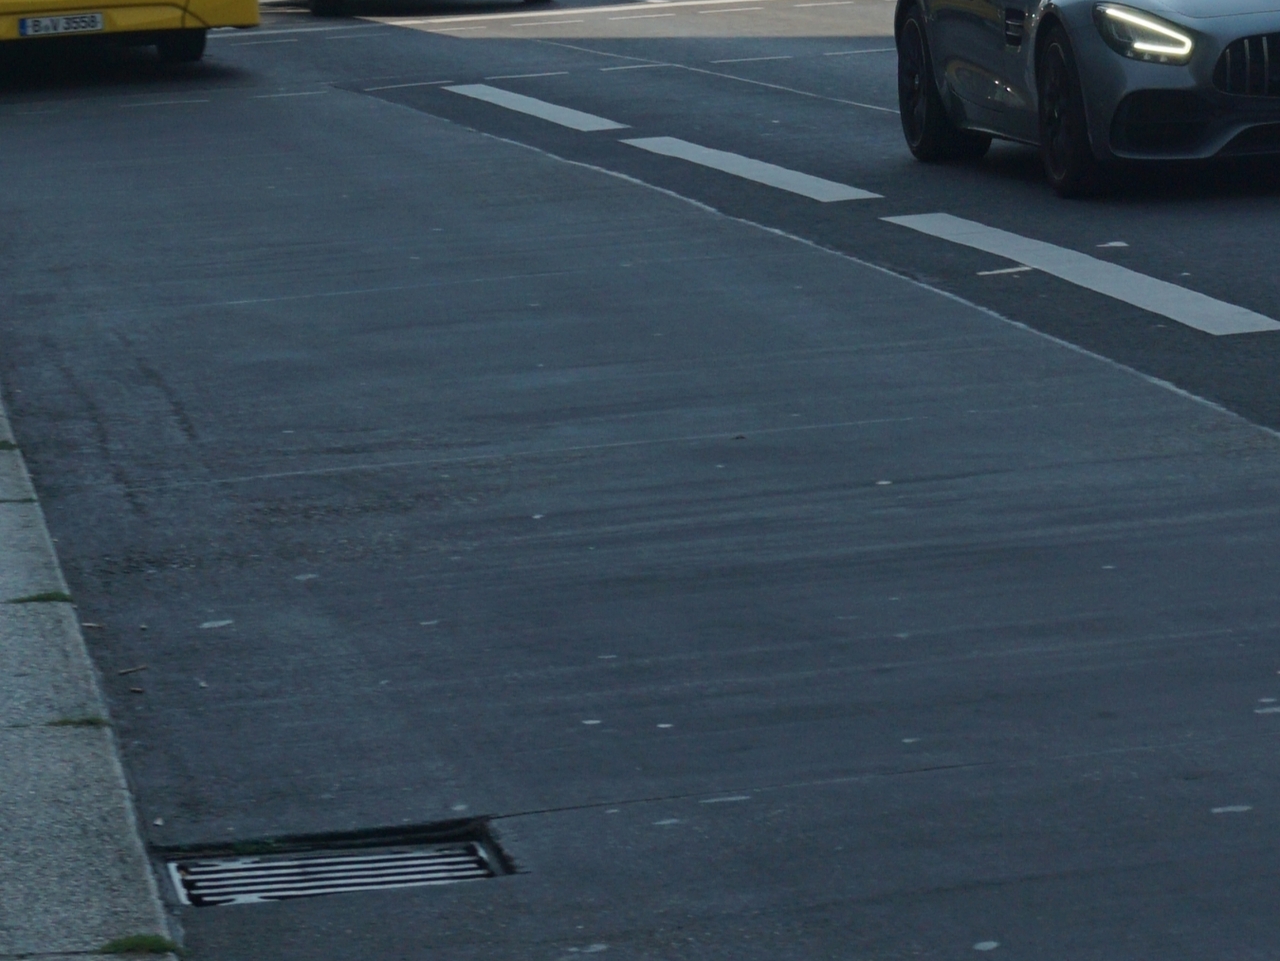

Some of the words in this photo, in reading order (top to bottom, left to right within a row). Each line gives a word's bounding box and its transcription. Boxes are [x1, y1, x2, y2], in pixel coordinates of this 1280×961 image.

[32, 19, 42, 33] B
[50, 17, 60, 32] V
[62, 14, 98, 31] 3558
